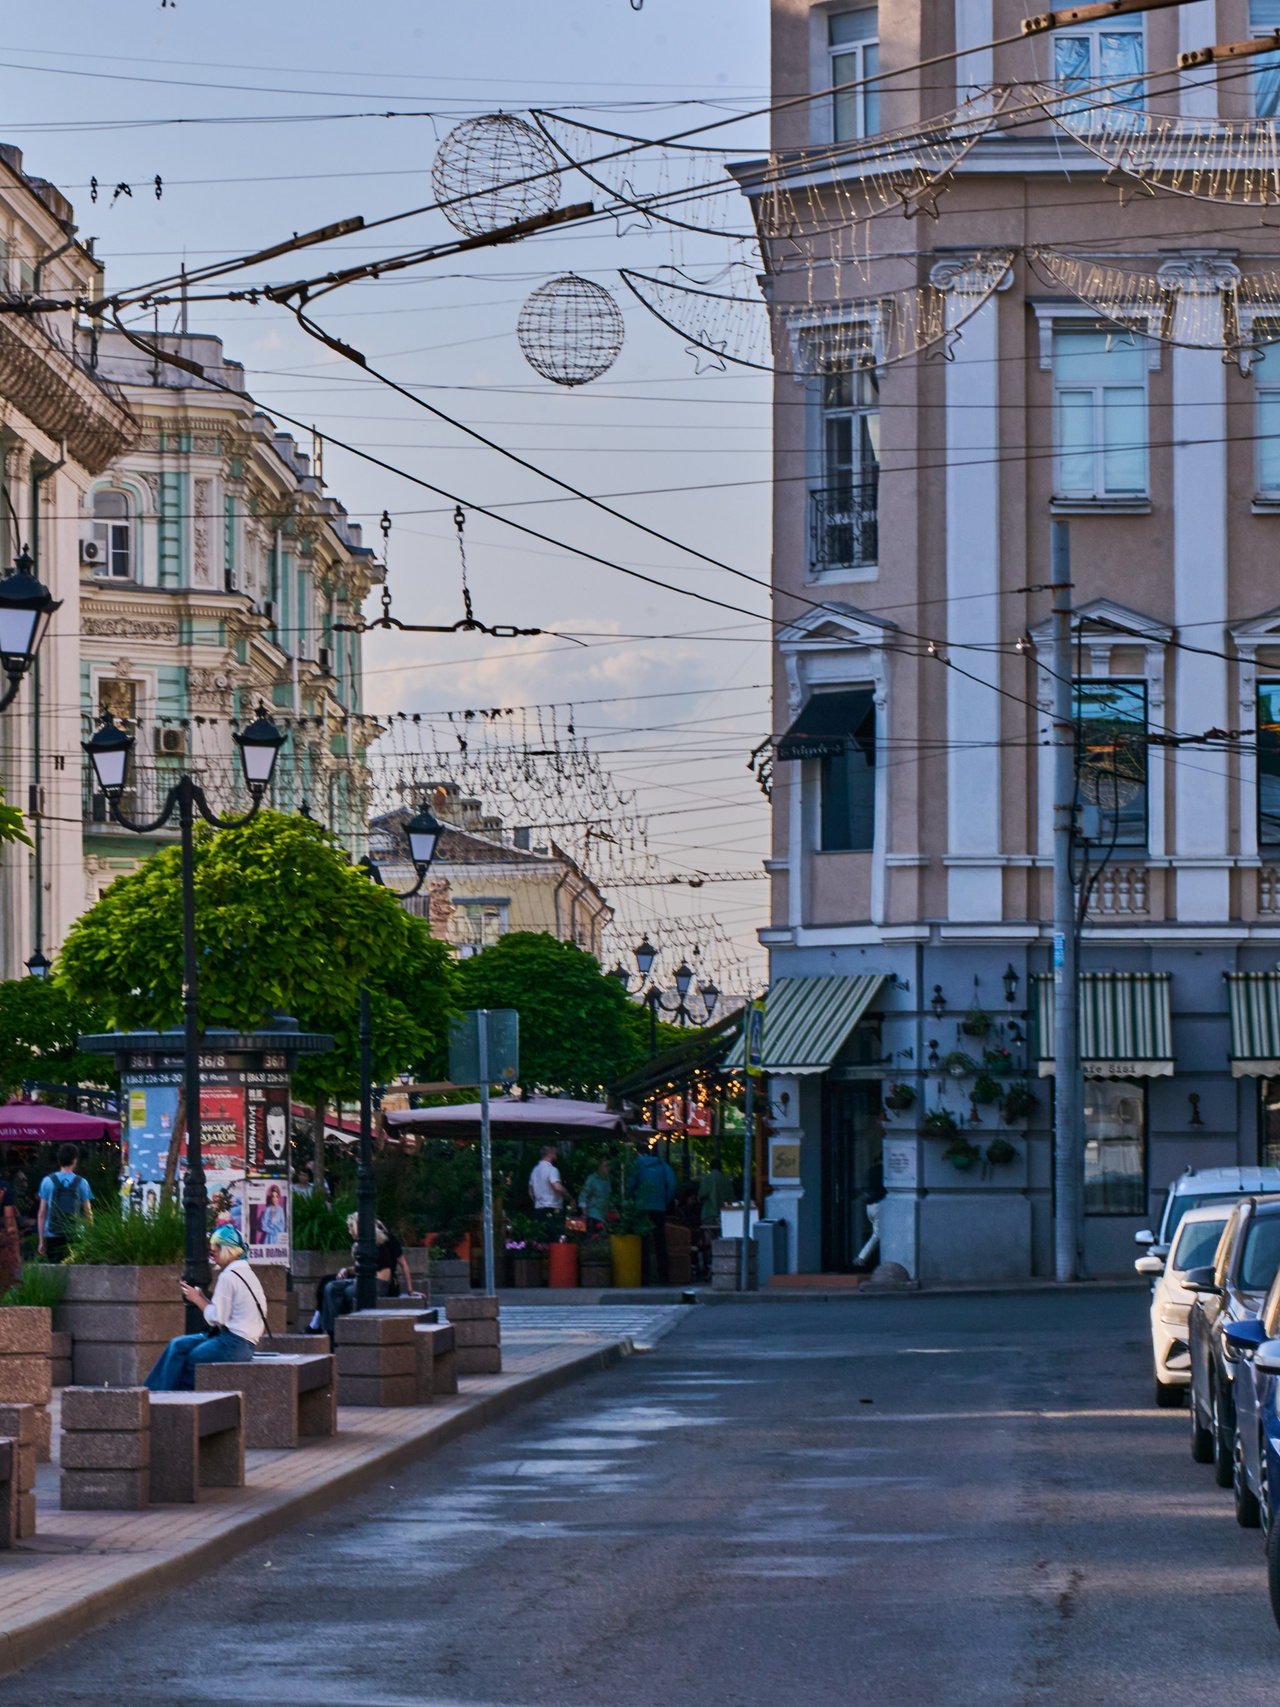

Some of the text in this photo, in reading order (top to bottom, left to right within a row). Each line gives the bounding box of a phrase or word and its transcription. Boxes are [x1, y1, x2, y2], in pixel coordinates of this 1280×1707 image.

[131, 1056, 153, 1068] 36/1
[198, 1055, 226, 1068] 36/8
[1082, 1063, 1104, 1074] afe
